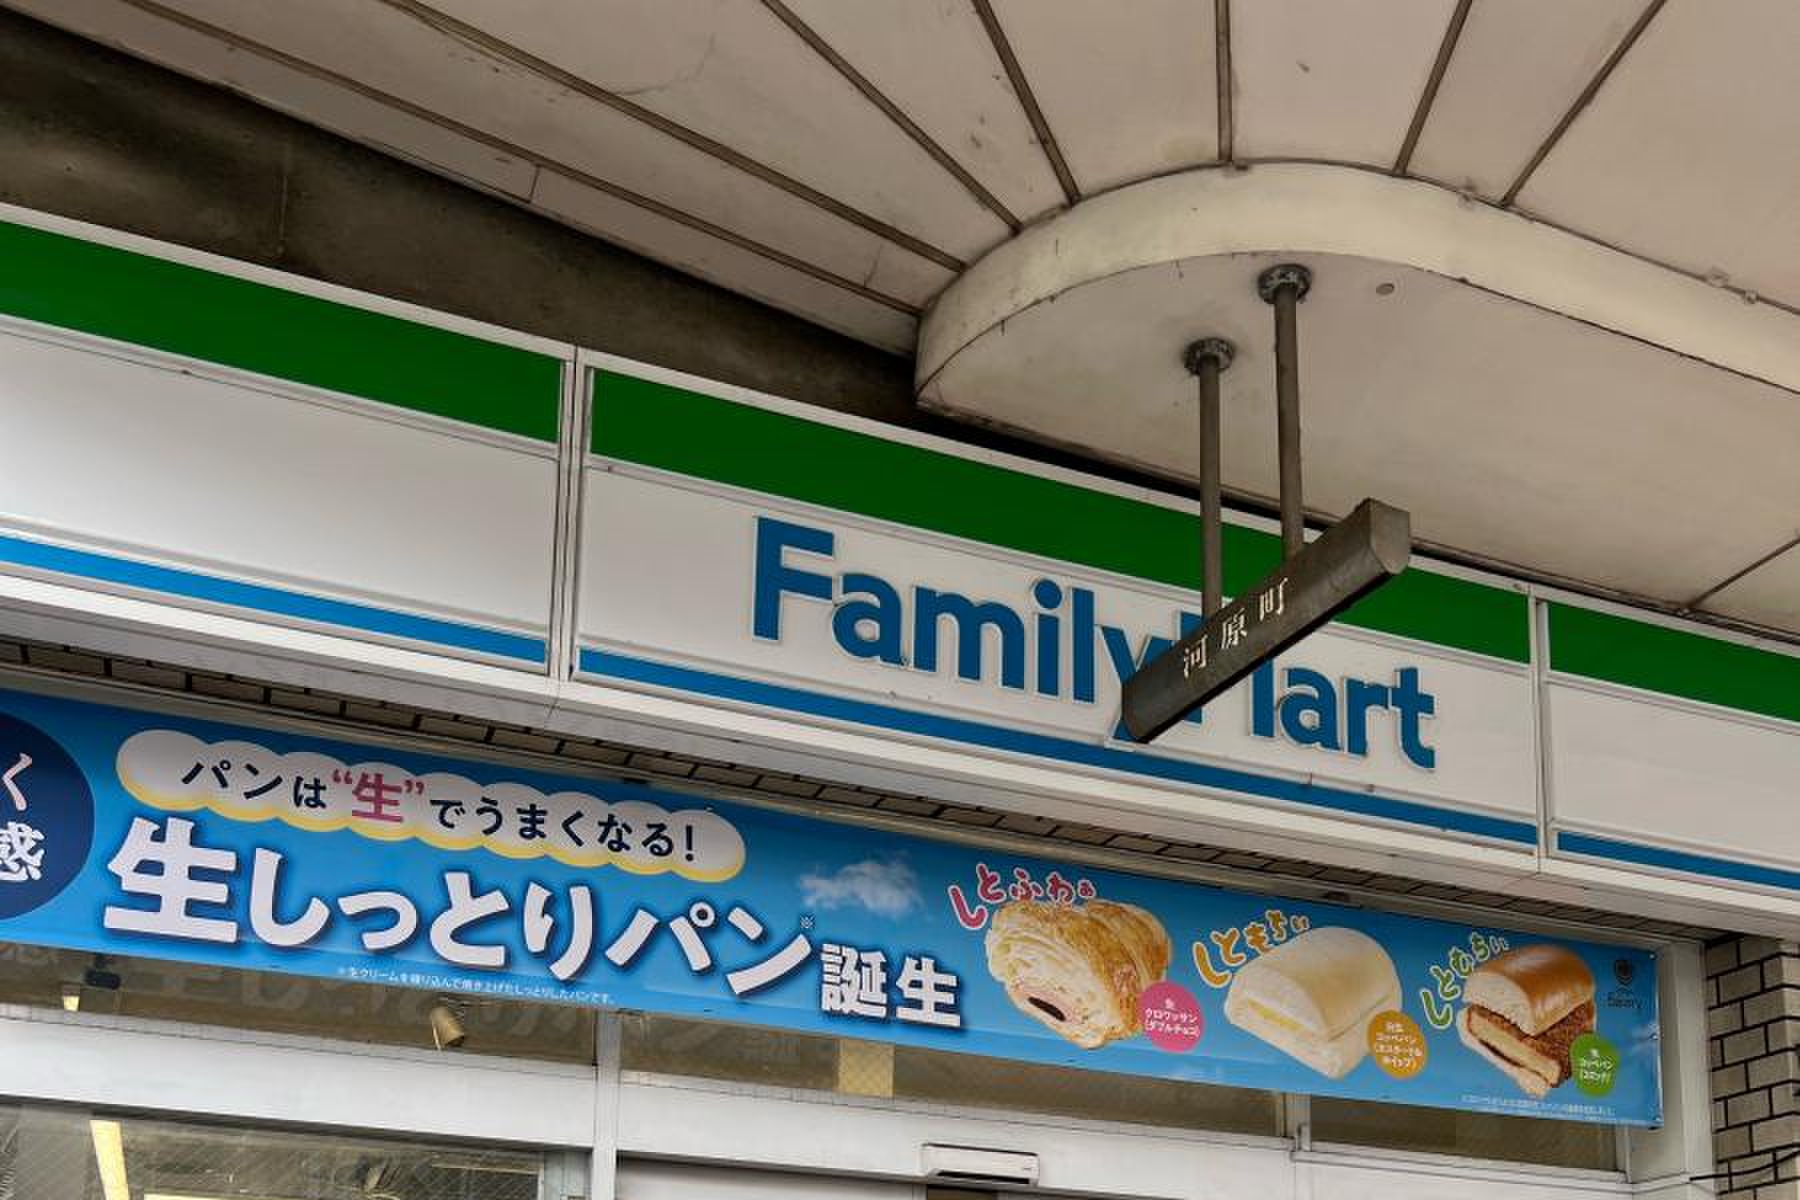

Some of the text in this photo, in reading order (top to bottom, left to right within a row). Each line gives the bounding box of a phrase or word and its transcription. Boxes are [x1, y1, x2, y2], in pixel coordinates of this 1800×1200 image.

[1183, 577, 1288, 678] 河原町
[820, 943, 961, 1028] 誕生
